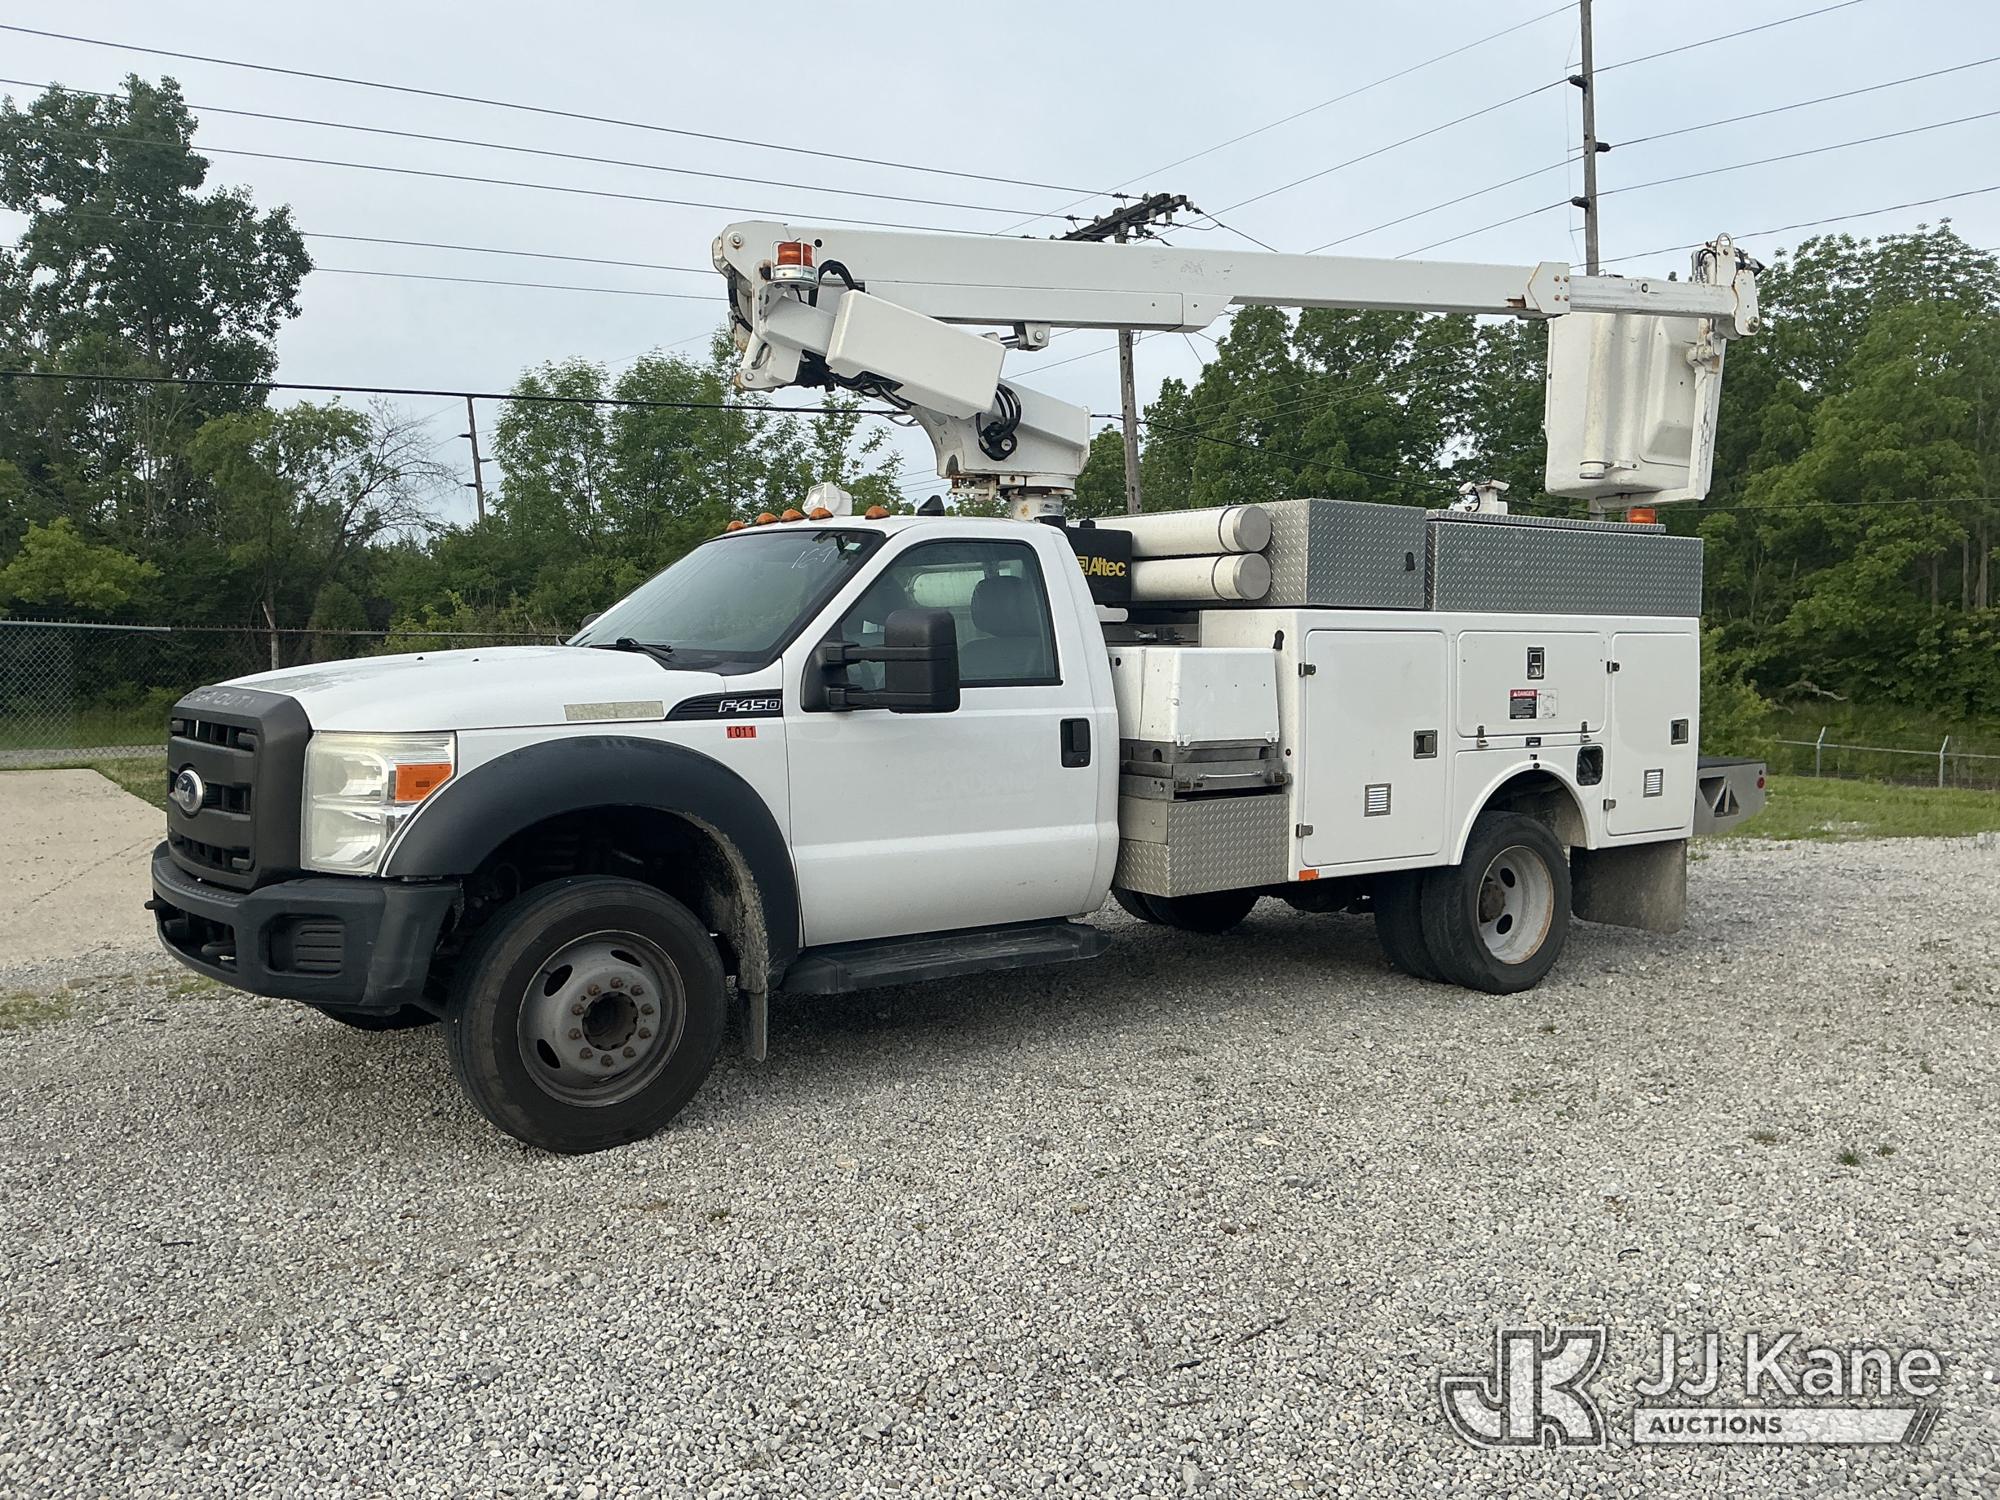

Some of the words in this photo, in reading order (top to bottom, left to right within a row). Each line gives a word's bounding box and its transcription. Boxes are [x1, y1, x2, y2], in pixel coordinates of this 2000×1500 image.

[1088, 556, 1127, 577] Altec
[718, 699, 781, 713] F-450
[727, 726, 756, 738] 1011
